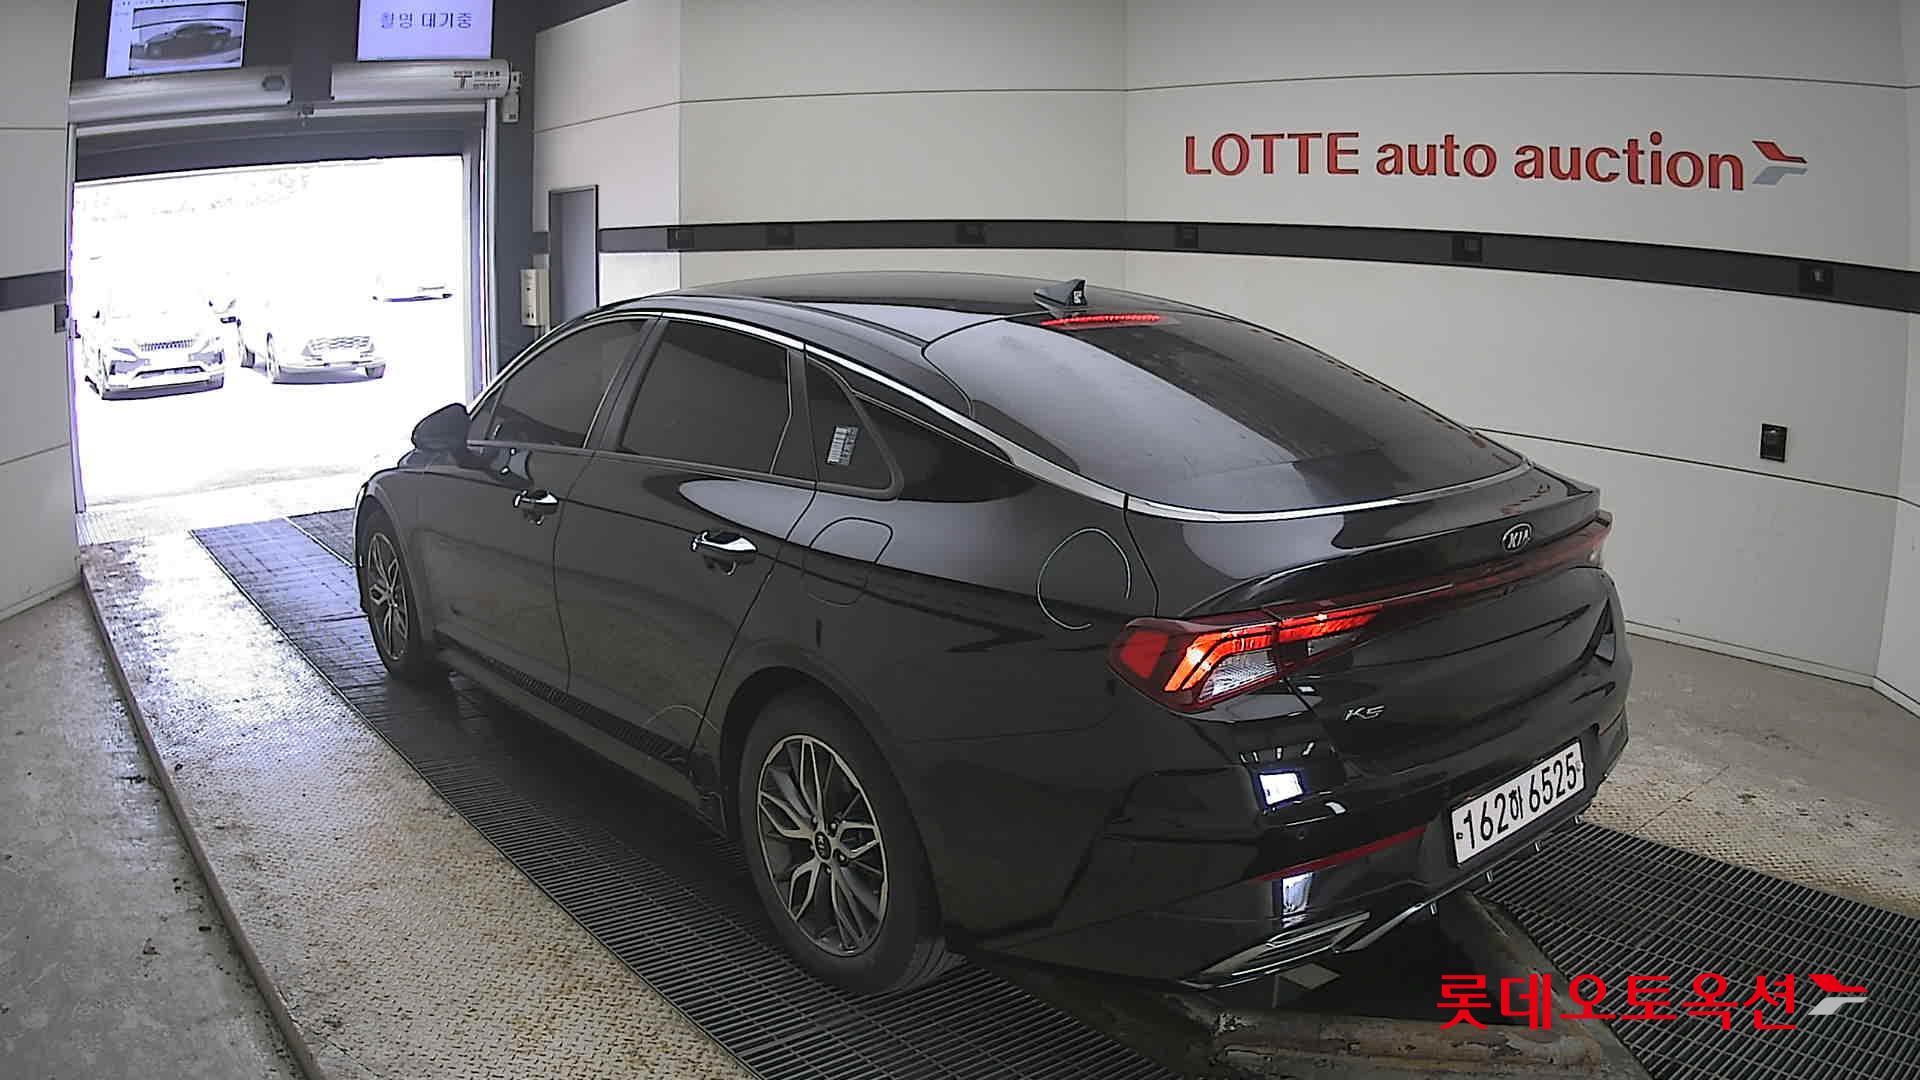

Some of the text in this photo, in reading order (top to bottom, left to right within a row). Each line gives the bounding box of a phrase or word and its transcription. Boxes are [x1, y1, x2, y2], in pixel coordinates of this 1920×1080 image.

[421, 11, 472, 29] 대기중
[1184, 131, 1744, 191] LOTTE auto auction
[1507, 529, 1530, 549] KIA
[1345, 705, 1385, 720] K5
[1529, 752, 1577, 813] 6525
